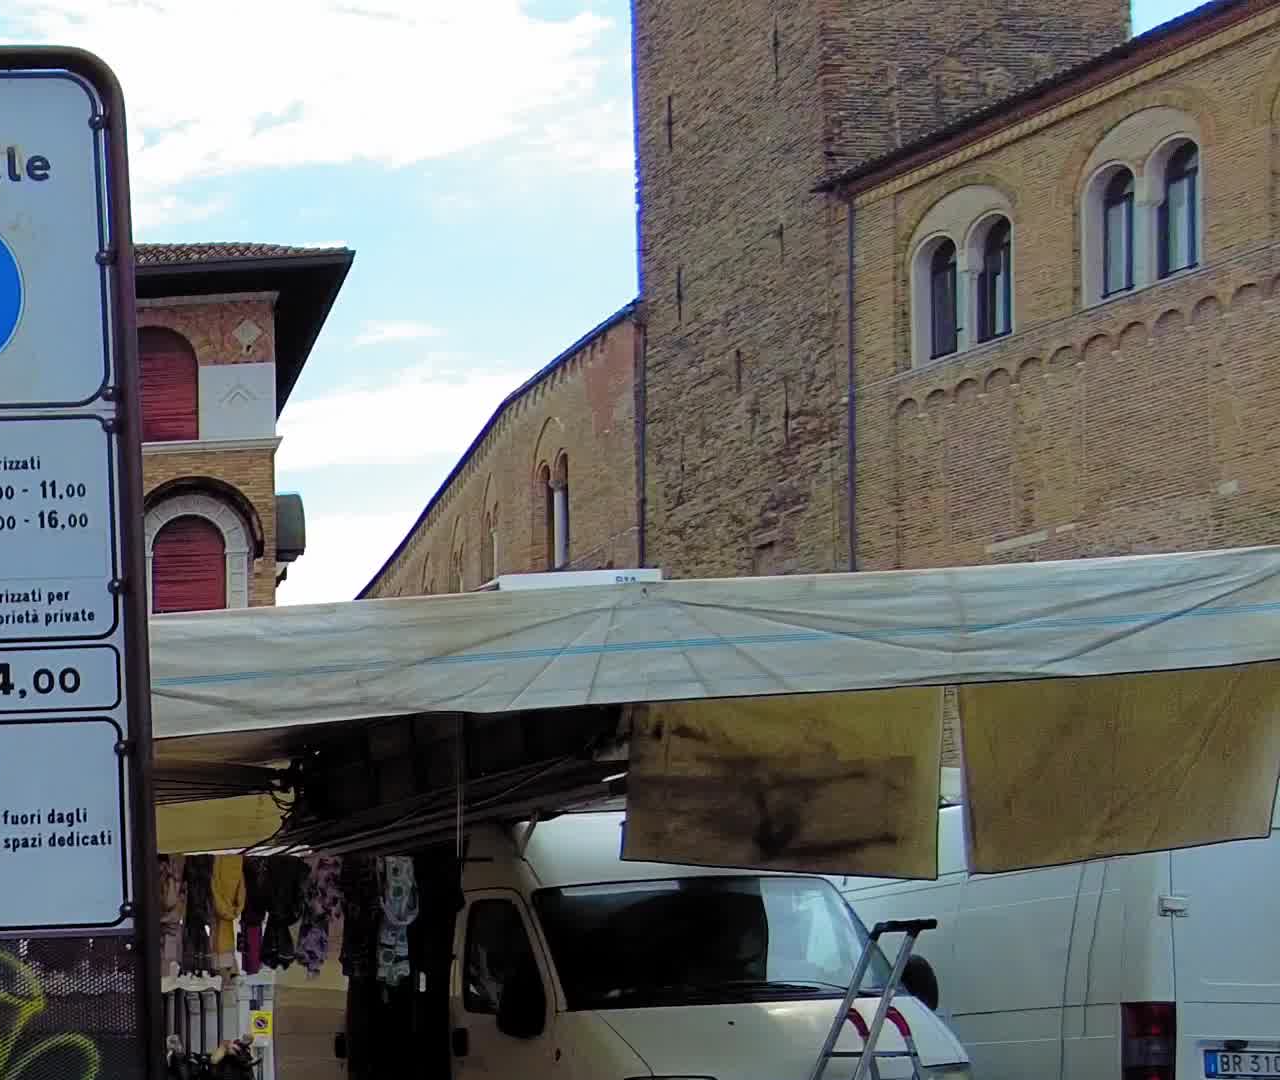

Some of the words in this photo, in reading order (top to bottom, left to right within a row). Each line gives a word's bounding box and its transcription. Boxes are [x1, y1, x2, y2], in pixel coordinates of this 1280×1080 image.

[47, 590, 70, 606] per
[44, 608, 95, 626] private
[2, 809, 41, 826] fuori
[47, 807, 88, 828] dagli
[3, 832, 43, 853] spazi
[47, 829, 112, 848] dedicati
[1219, 1055, 1243, 1073] BR
